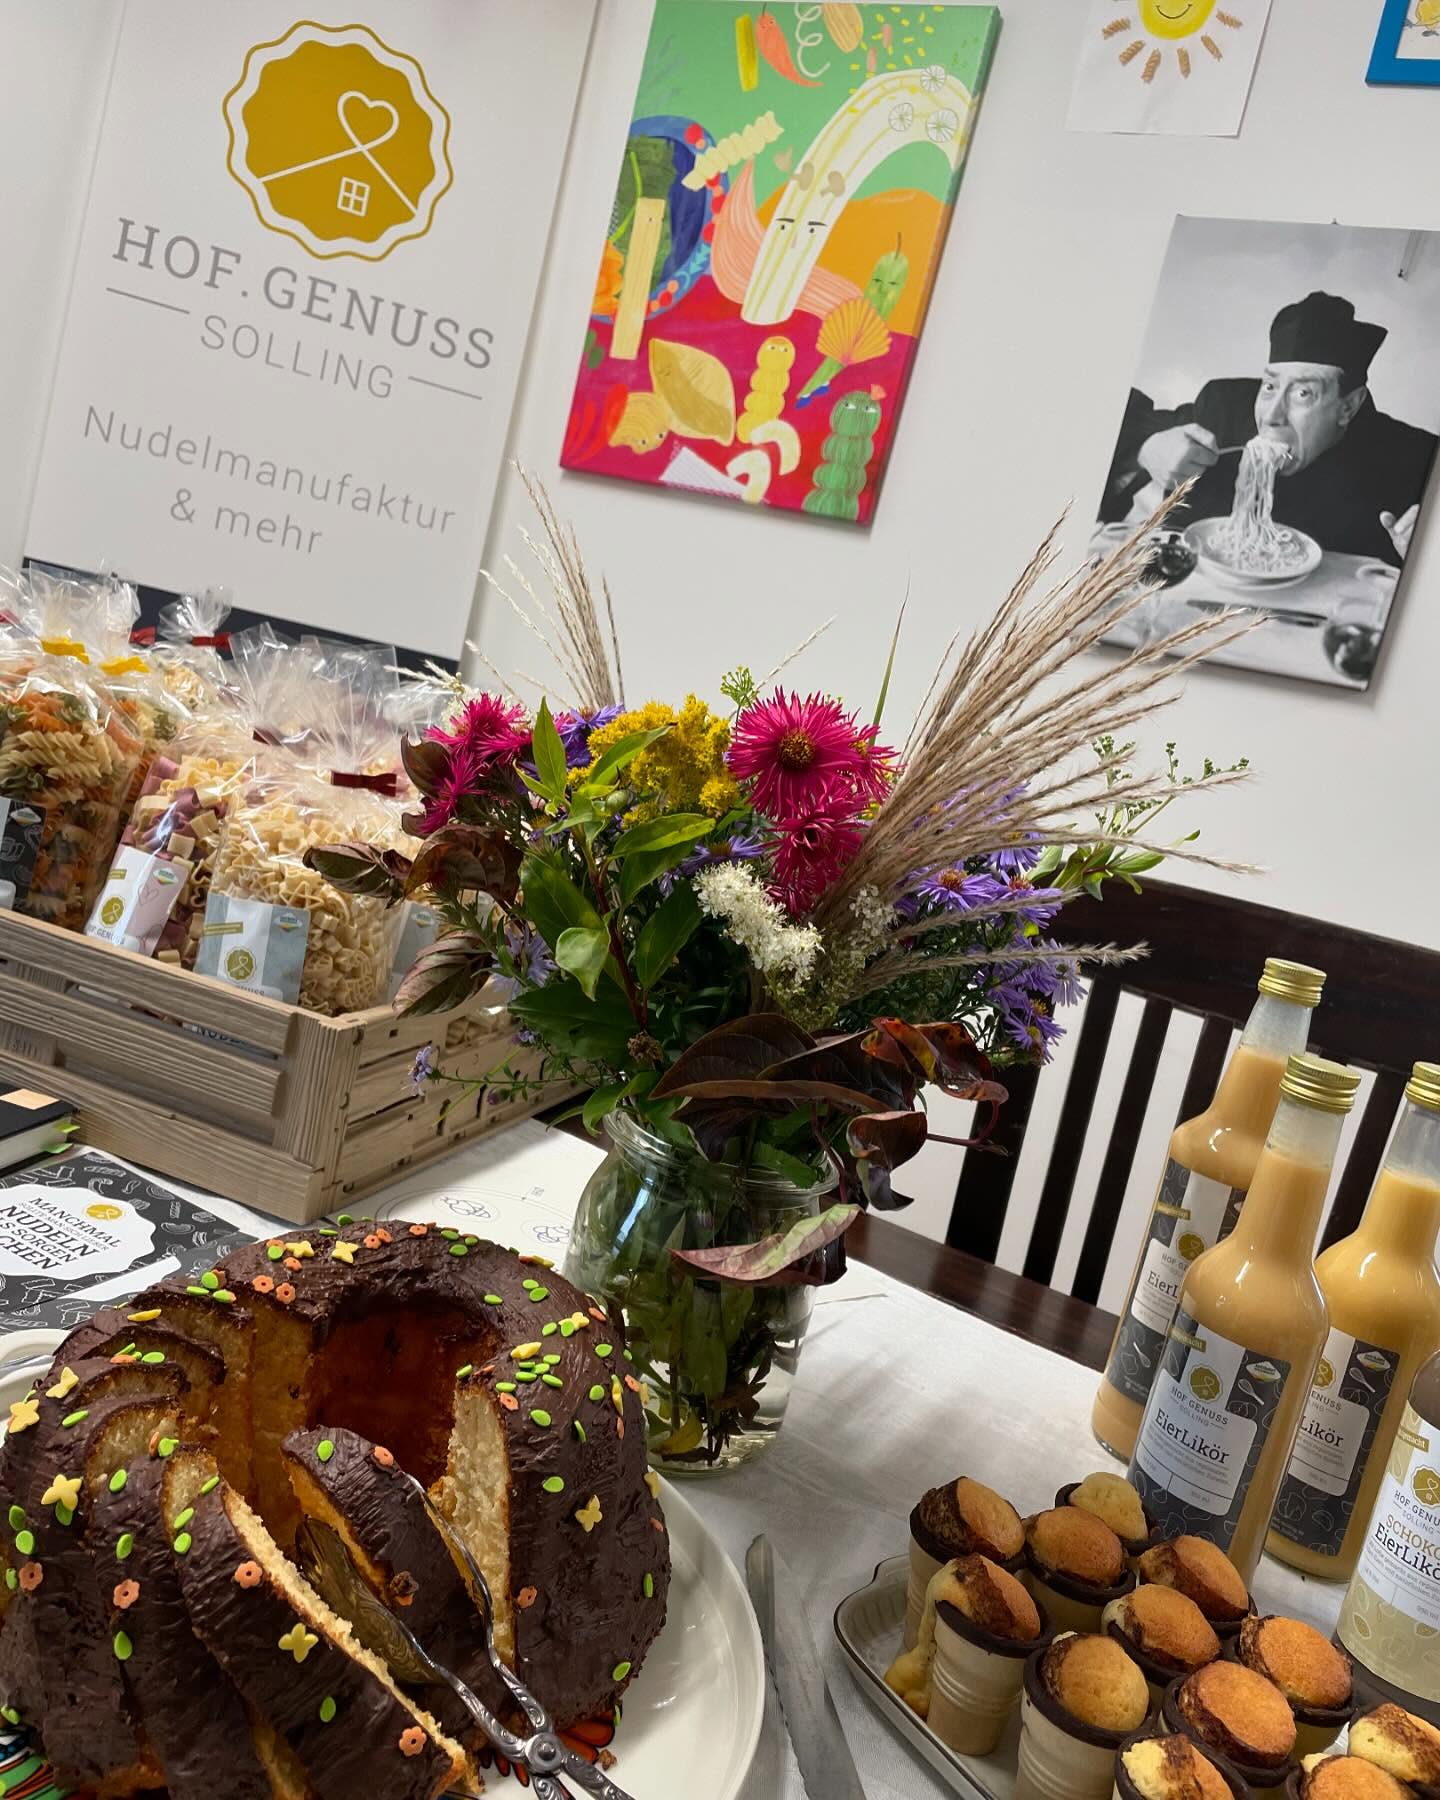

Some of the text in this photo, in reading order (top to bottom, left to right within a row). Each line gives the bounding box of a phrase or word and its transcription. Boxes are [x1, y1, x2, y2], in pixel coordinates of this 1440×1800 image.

[200, 315, 394, 399] SOLLING
[84, 405, 456, 533] Nudelmanufaktur
[170, 488, 323, 554] & mehr
[0, 1205, 99, 1257] NUDELN
[11, 1228, 79, 1262] SORGEN
[29, 1197, 122, 1247] MANCHMAL
[1147, 1270, 1180, 1299] EierL
[1188, 1398, 1229, 1425] GENUSS
[1311, 1391, 1342, 1412] ENUSS
[1155, 1407, 1230, 1464] EierLikör
[1299, 1415, 1344, 1448] Likör
[1411, 1504, 1440, 1526] GENU
[1374, 1522, 1440, 1581] EierLikö
